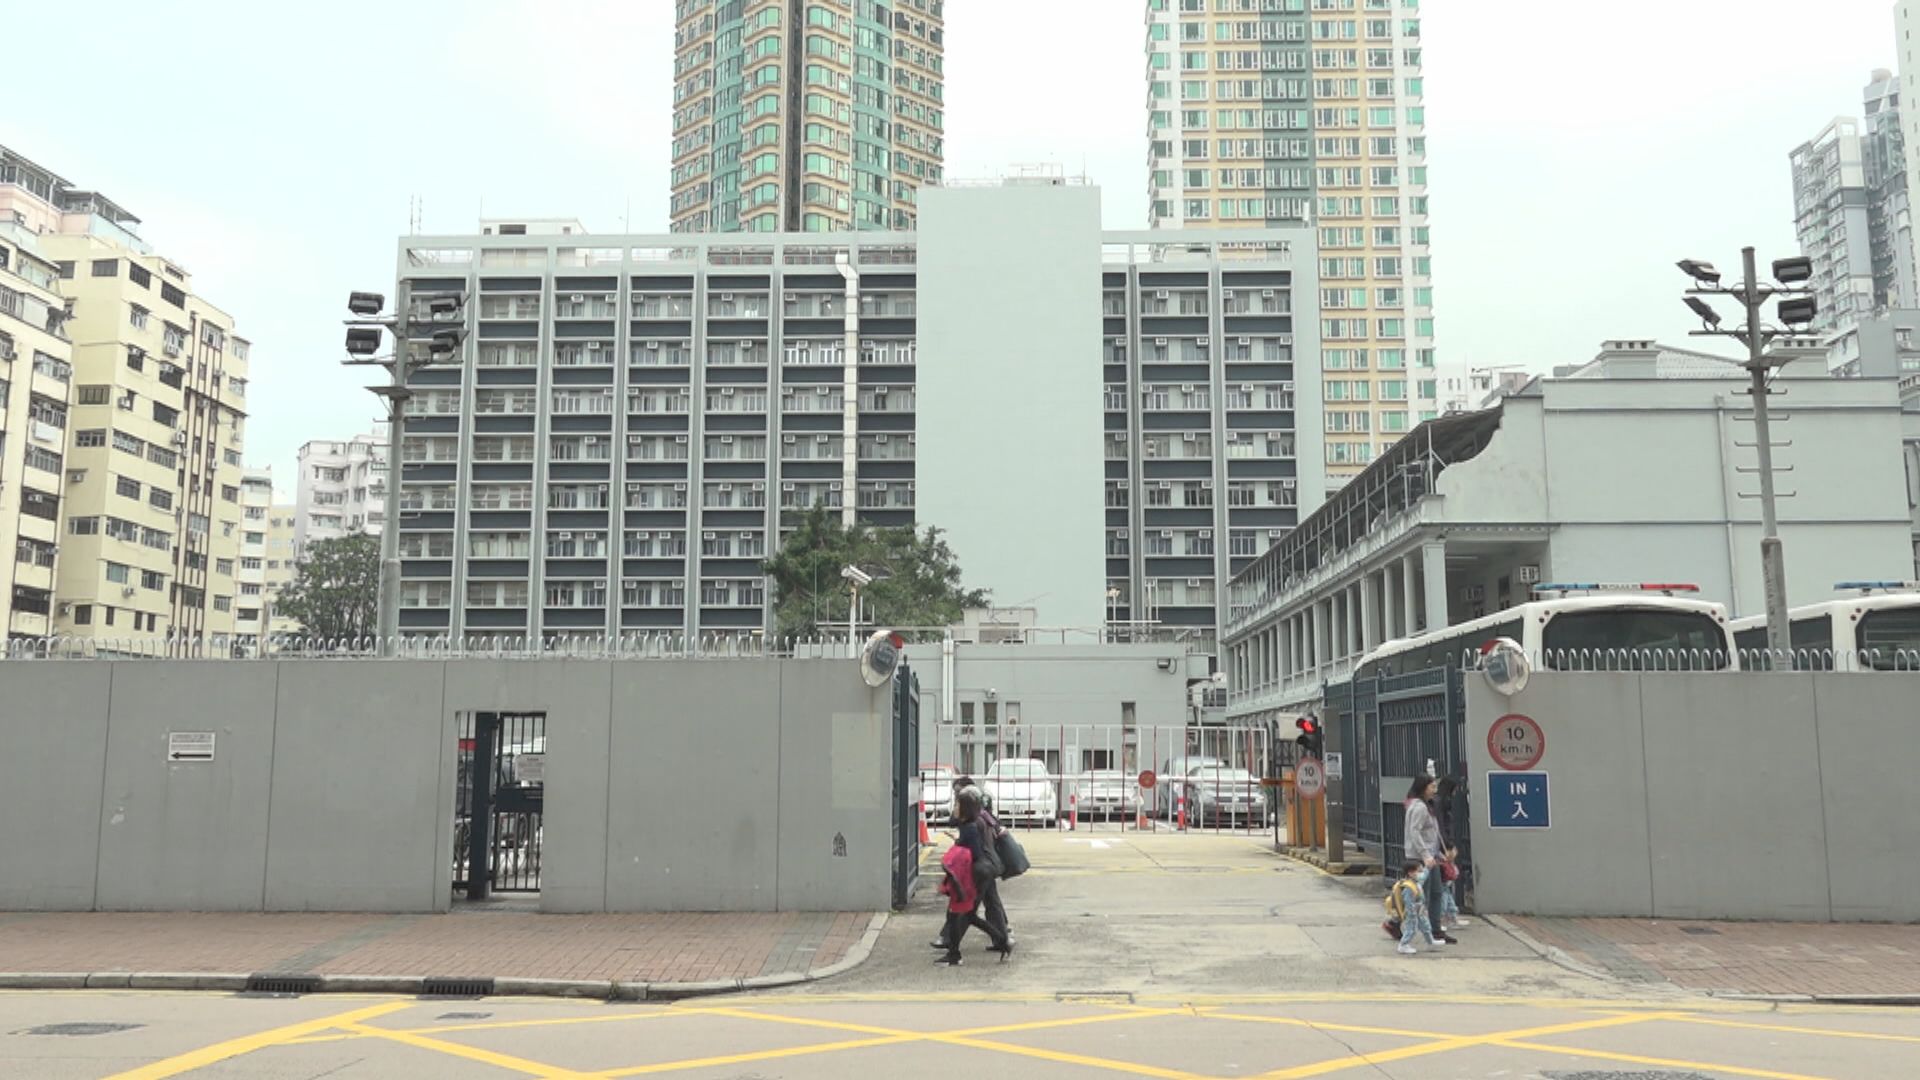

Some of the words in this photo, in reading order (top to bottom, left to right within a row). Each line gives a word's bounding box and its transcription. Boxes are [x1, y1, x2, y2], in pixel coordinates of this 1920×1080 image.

[1507, 726, 1525, 741] 10
[1304, 766, 1315, 778] 10
[1510, 782, 1527, 795] IN
[1511, 800, 1529, 819] 入
